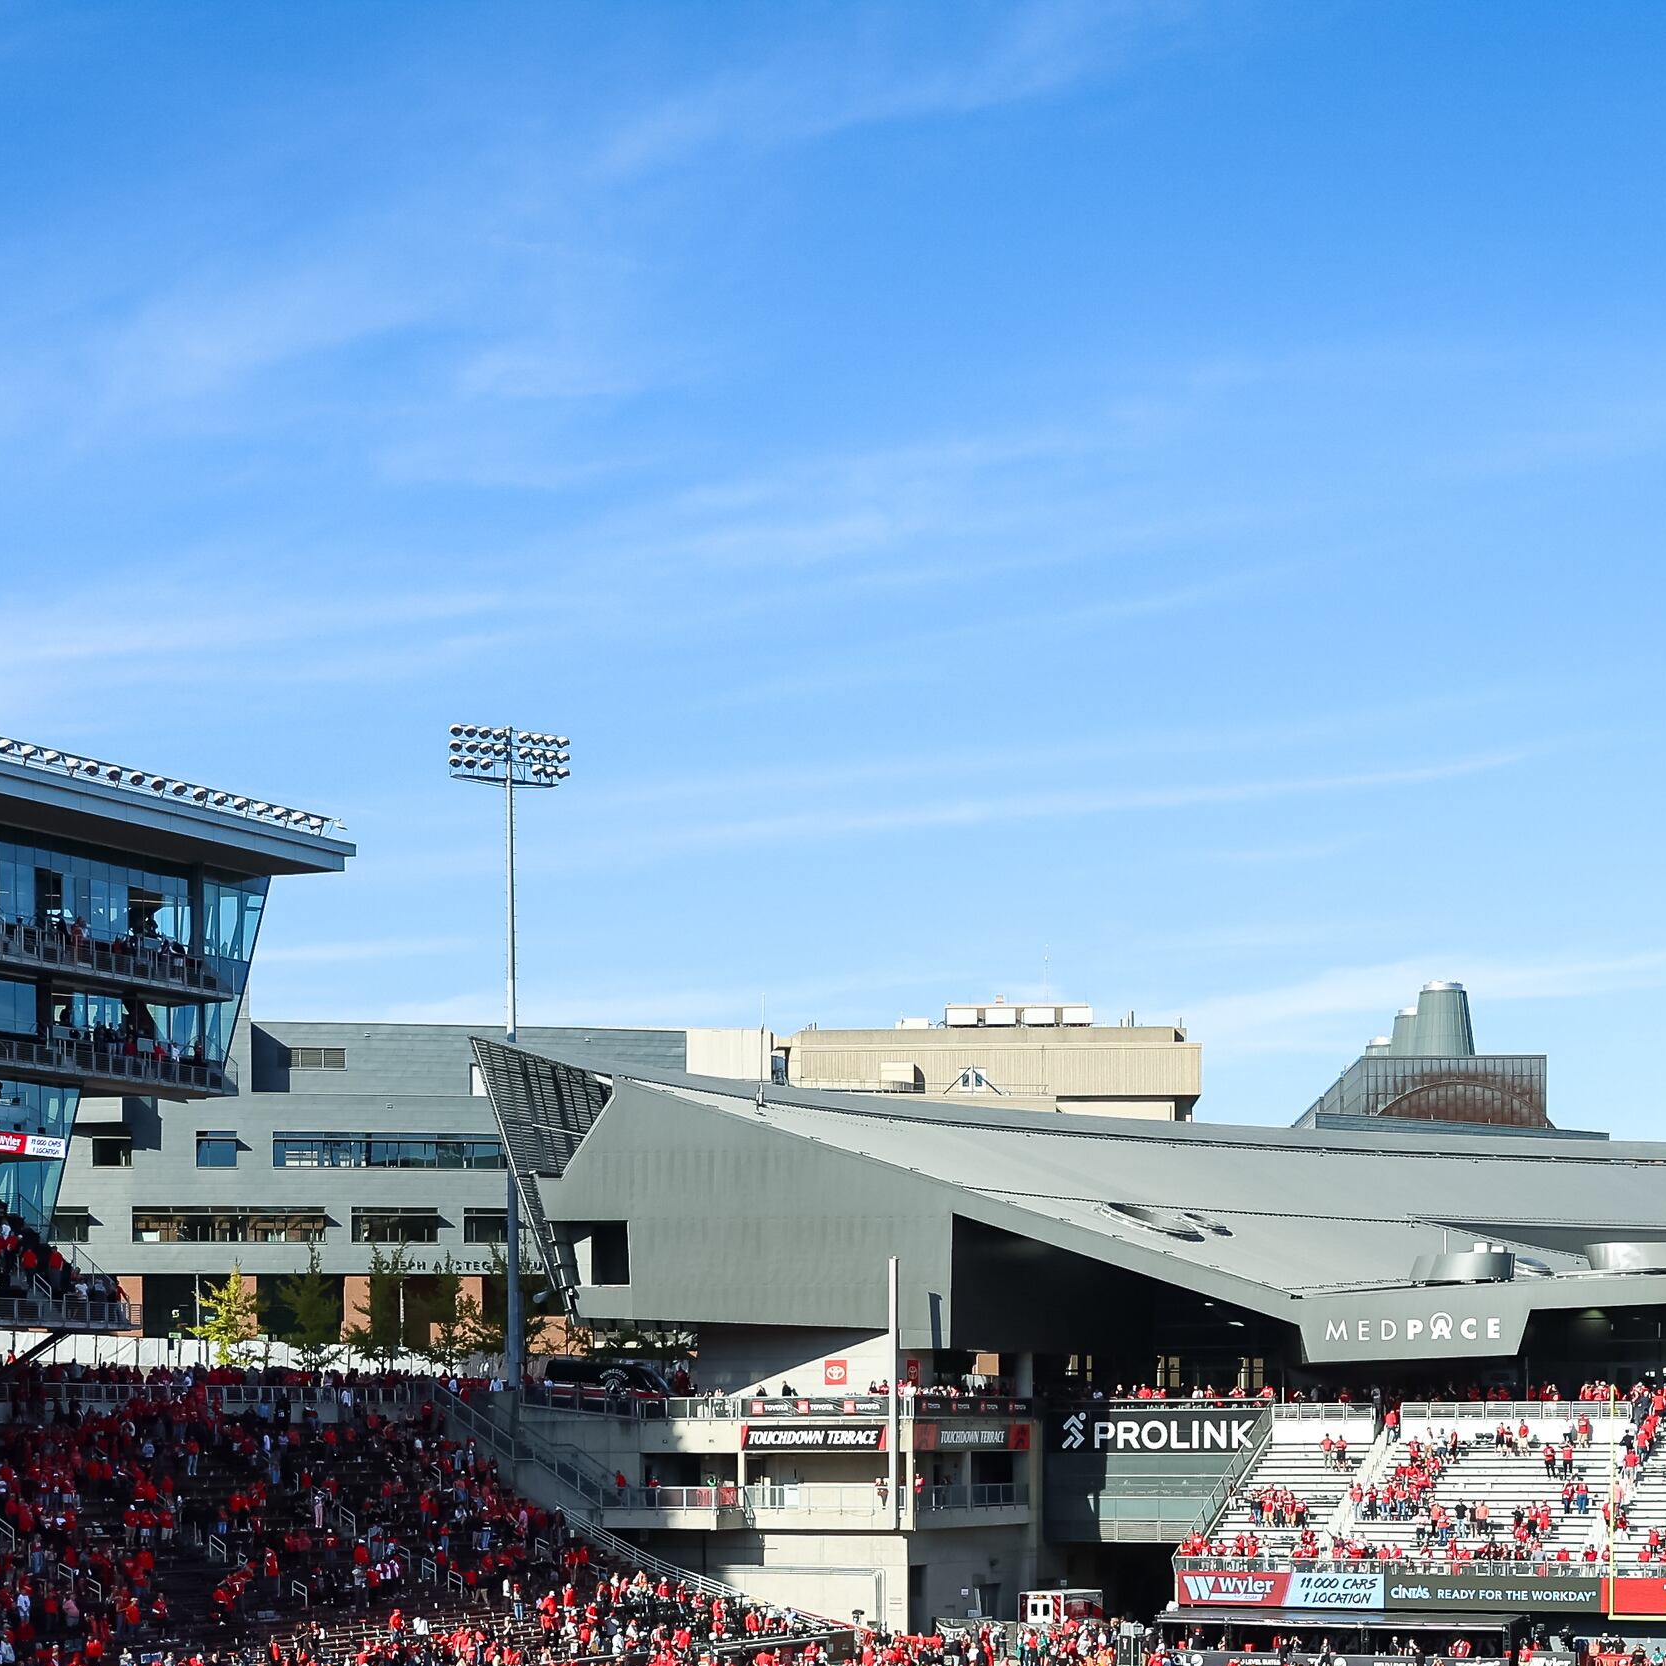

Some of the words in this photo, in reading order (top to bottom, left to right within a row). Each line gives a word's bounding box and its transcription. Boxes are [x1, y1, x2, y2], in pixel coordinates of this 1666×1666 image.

[1324, 1310, 1501, 1342] MEDPACE
[764, 1404, 788, 1412] TOYOTA
[809, 1404, 834, 1412] TOYOTA
[855, 1402, 880, 1411] TOYOTA
[748, 1430, 824, 1445] TOUCHDOWN
[827, 1430, 878, 1445] TERRACE
[939, 1430, 979, 1444] TOUCHDOWN
[979, 1430, 1006, 1444] TERRACE
[1093, 1420, 1255, 1450] PROLINK
[1217, 1575, 1275, 1597] Wyler
[1342, 1577, 1378, 1589] CARS
[1312, 1592, 1372, 1604] LOCATION
[1437, 1588, 1476, 1600] READY
[1478, 1589, 1503, 1600] FOR
[1505, 1589, 1529, 1601] THE
